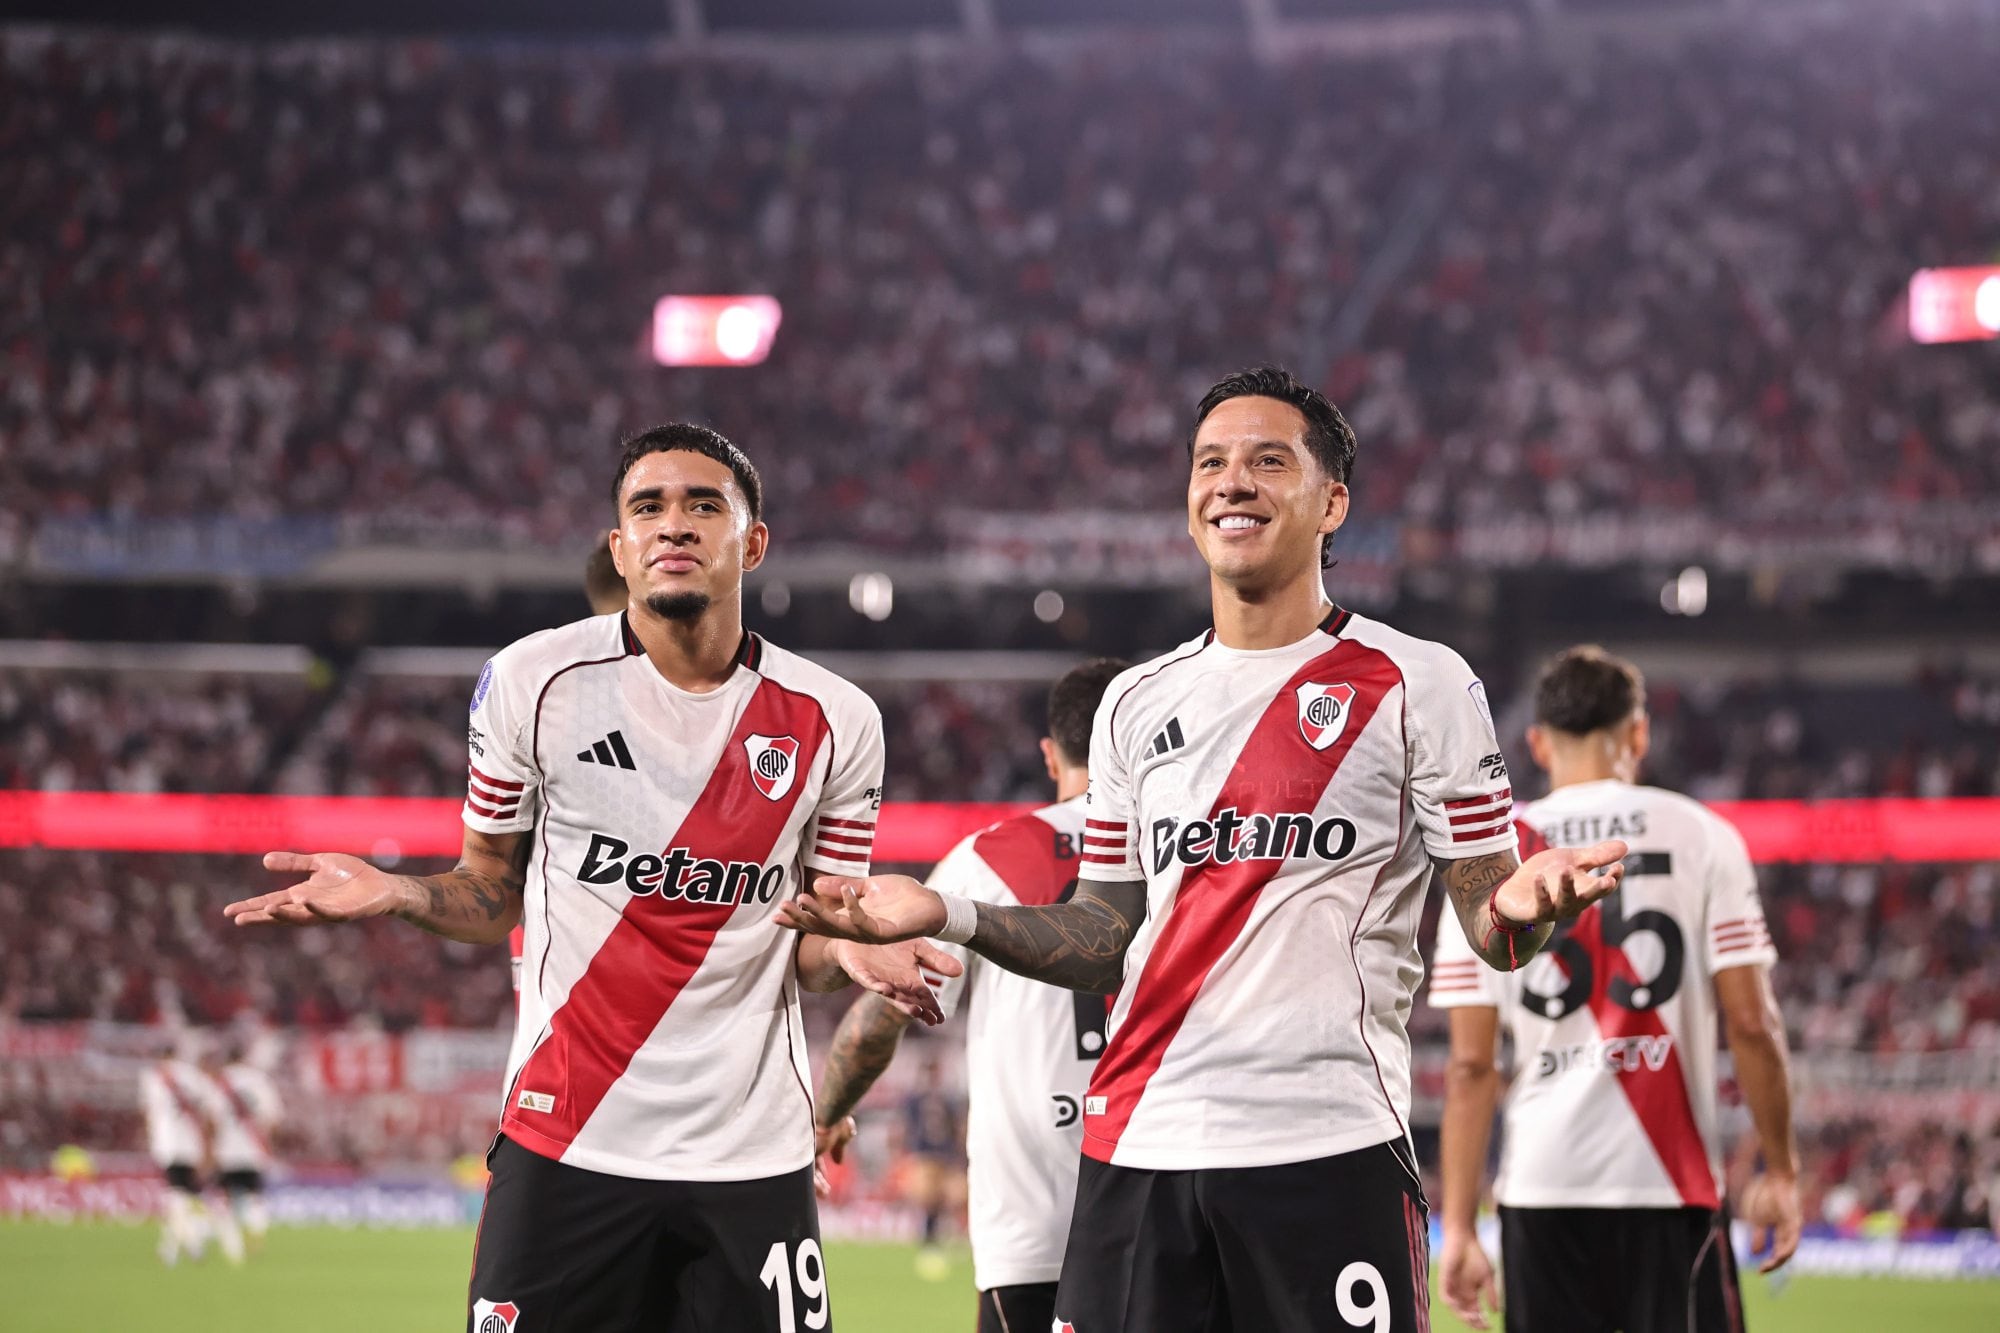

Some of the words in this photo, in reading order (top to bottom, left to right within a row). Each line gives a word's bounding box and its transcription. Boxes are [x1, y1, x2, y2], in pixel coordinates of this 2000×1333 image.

[1307, 696, 1341, 727] CARP
[757, 748, 789, 779] CARP
[576, 832, 785, 906] Betano
[1152, 805, 1358, 877] Betano
[759, 1238, 828, 1333] 19
[1334, 1260, 1391, 1333] 9
